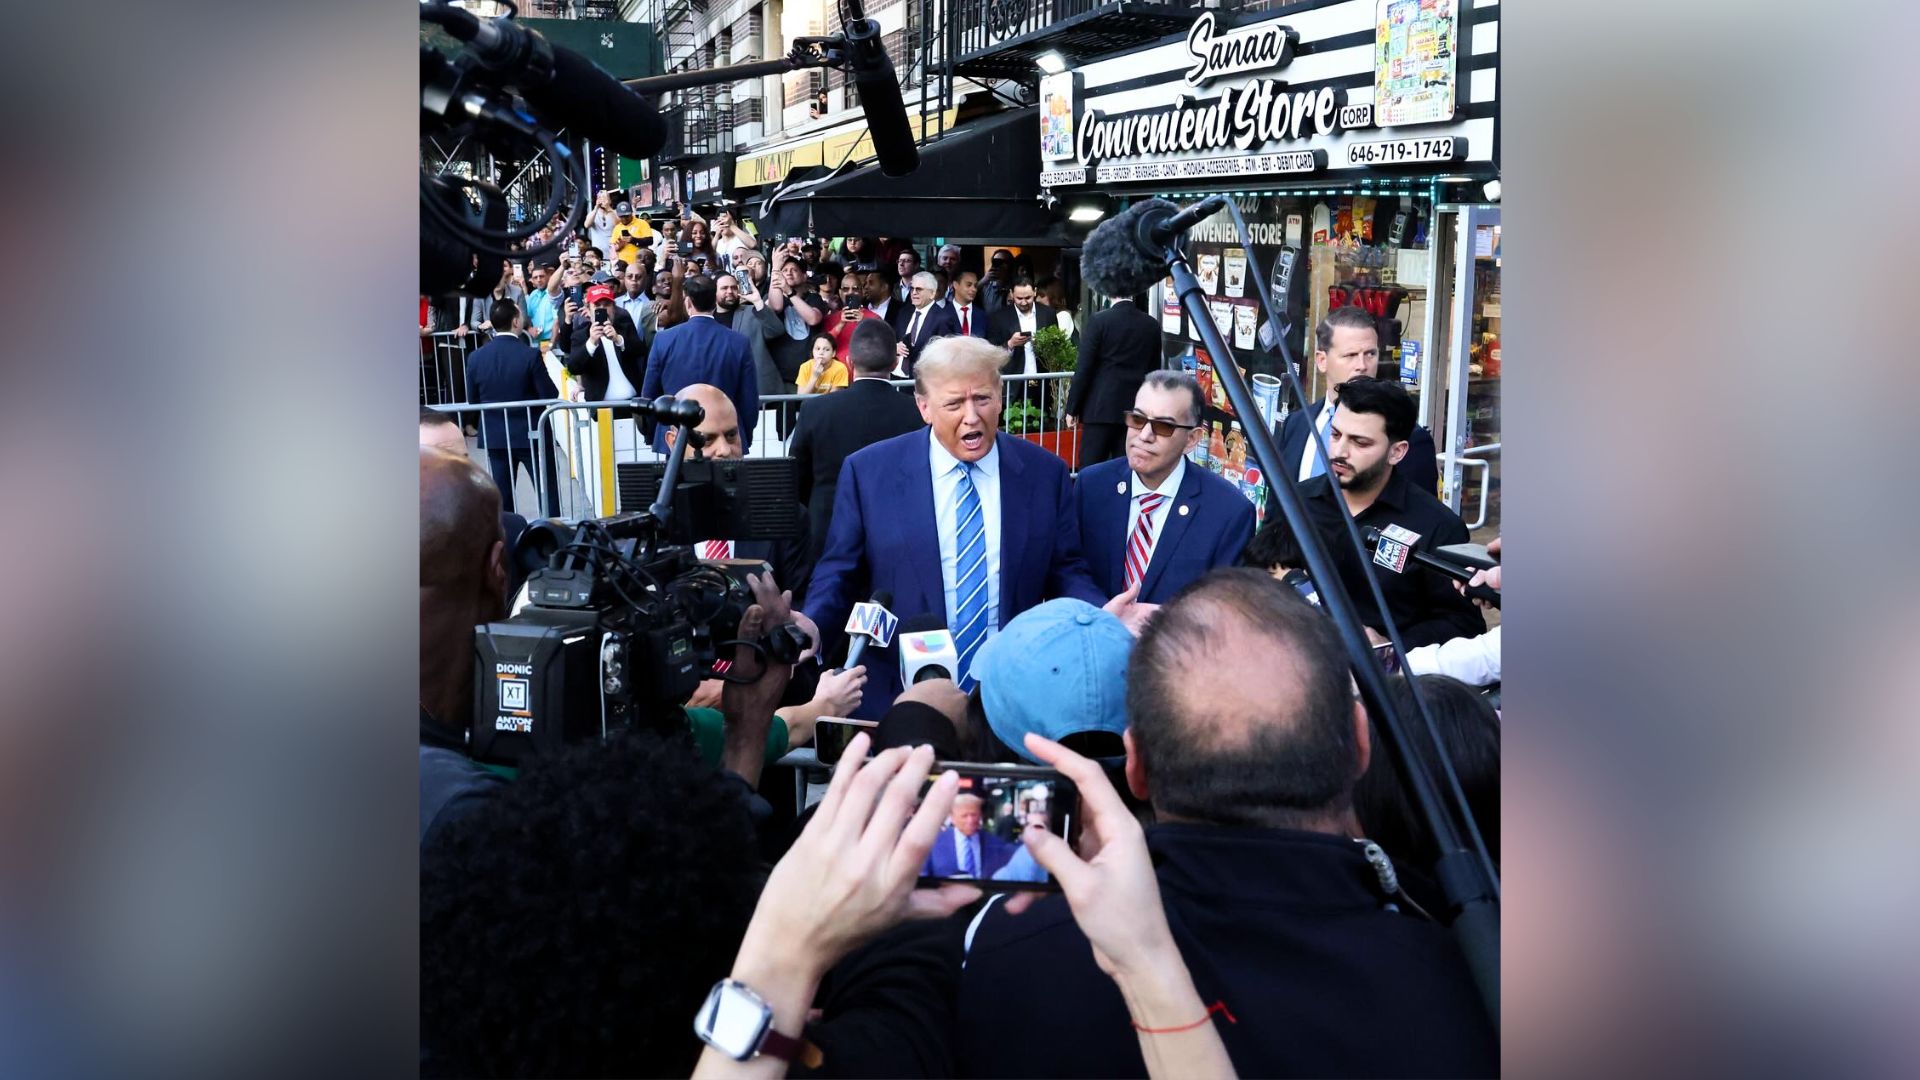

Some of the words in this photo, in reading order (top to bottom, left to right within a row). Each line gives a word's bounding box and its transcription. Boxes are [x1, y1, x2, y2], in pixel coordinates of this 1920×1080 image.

[1188, 17, 1280, 82] Sanaa
[1077, 86, 1234, 166] Convenient
[1234, 79, 1338, 150] Store
[1350, 139, 1452, 163] 646-719-1742
[1053, 170, 1085, 184] BROADWAY
[1134, 164, 1160, 179] BEVERAGES
[1163, 163, 1179, 177] CANDY
[1183, 161, 1206, 176] HOOKAH
[1207, 159, 1241, 175] ACCESSORIES
[1245, 158, 1257, 172] ATM
[1261, 157, 1272, 171] EBT
[1277, 155, 1294, 170] DEBIT
[1295, 153, 1313, 169] CARD
[1288, 217, 1300, 225] ATM
[1248, 223, 1282, 245] STORE
[1382, 540, 1394, 559] FOX
[1389, 543, 1402, 568] NEWS
[496, 663, 533, 675] DIONIC
[506, 686, 521, 699] XT
